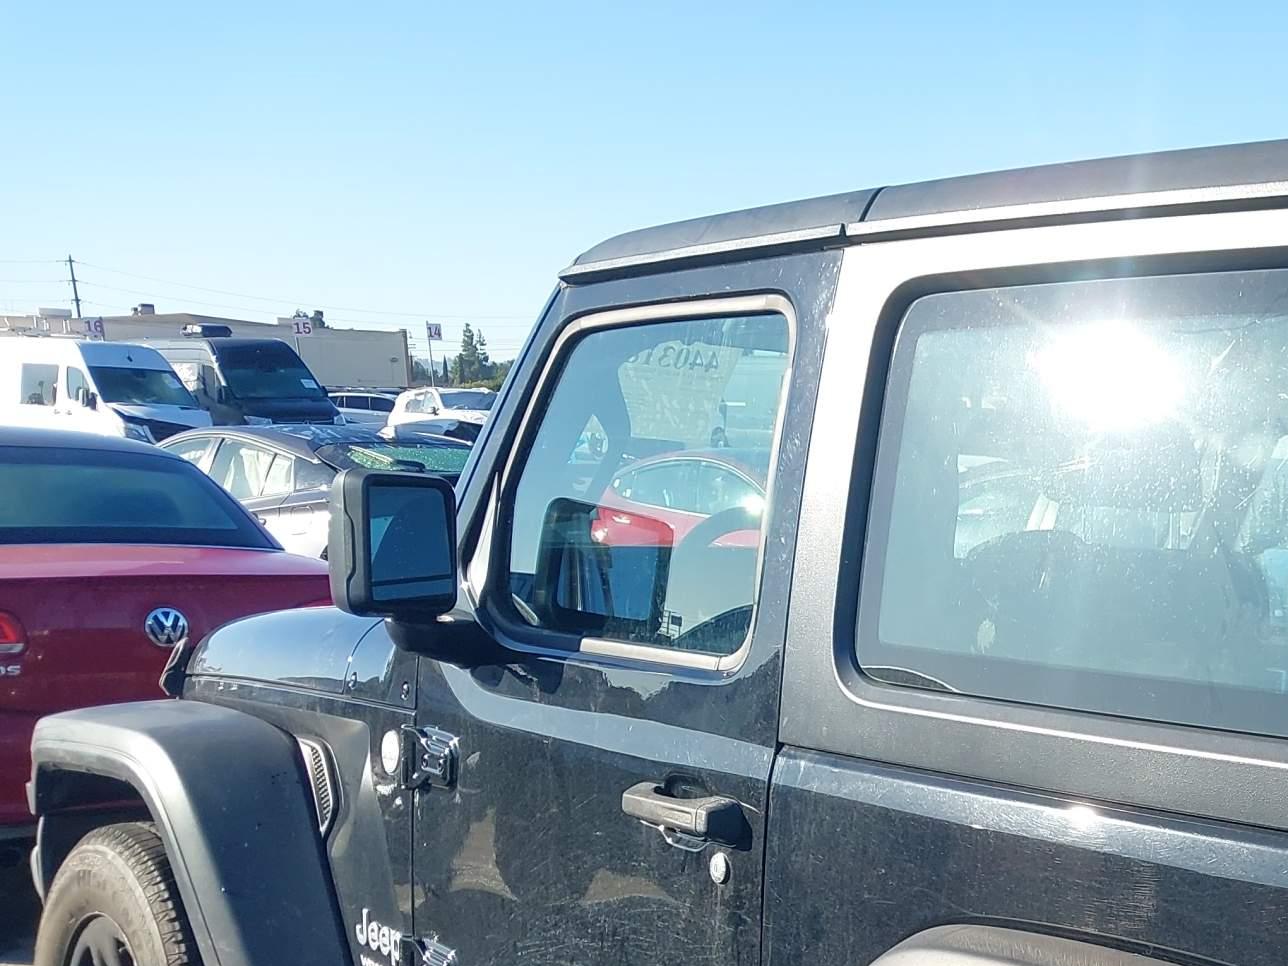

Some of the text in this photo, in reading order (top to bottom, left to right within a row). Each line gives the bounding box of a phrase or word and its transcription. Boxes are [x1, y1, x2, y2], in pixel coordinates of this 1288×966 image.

[84, 319, 104, 333] 16
[293, 321, 312, 335] 15
[427, 326, 442, 338] 14
[355, 908, 401, 966] Jeep
